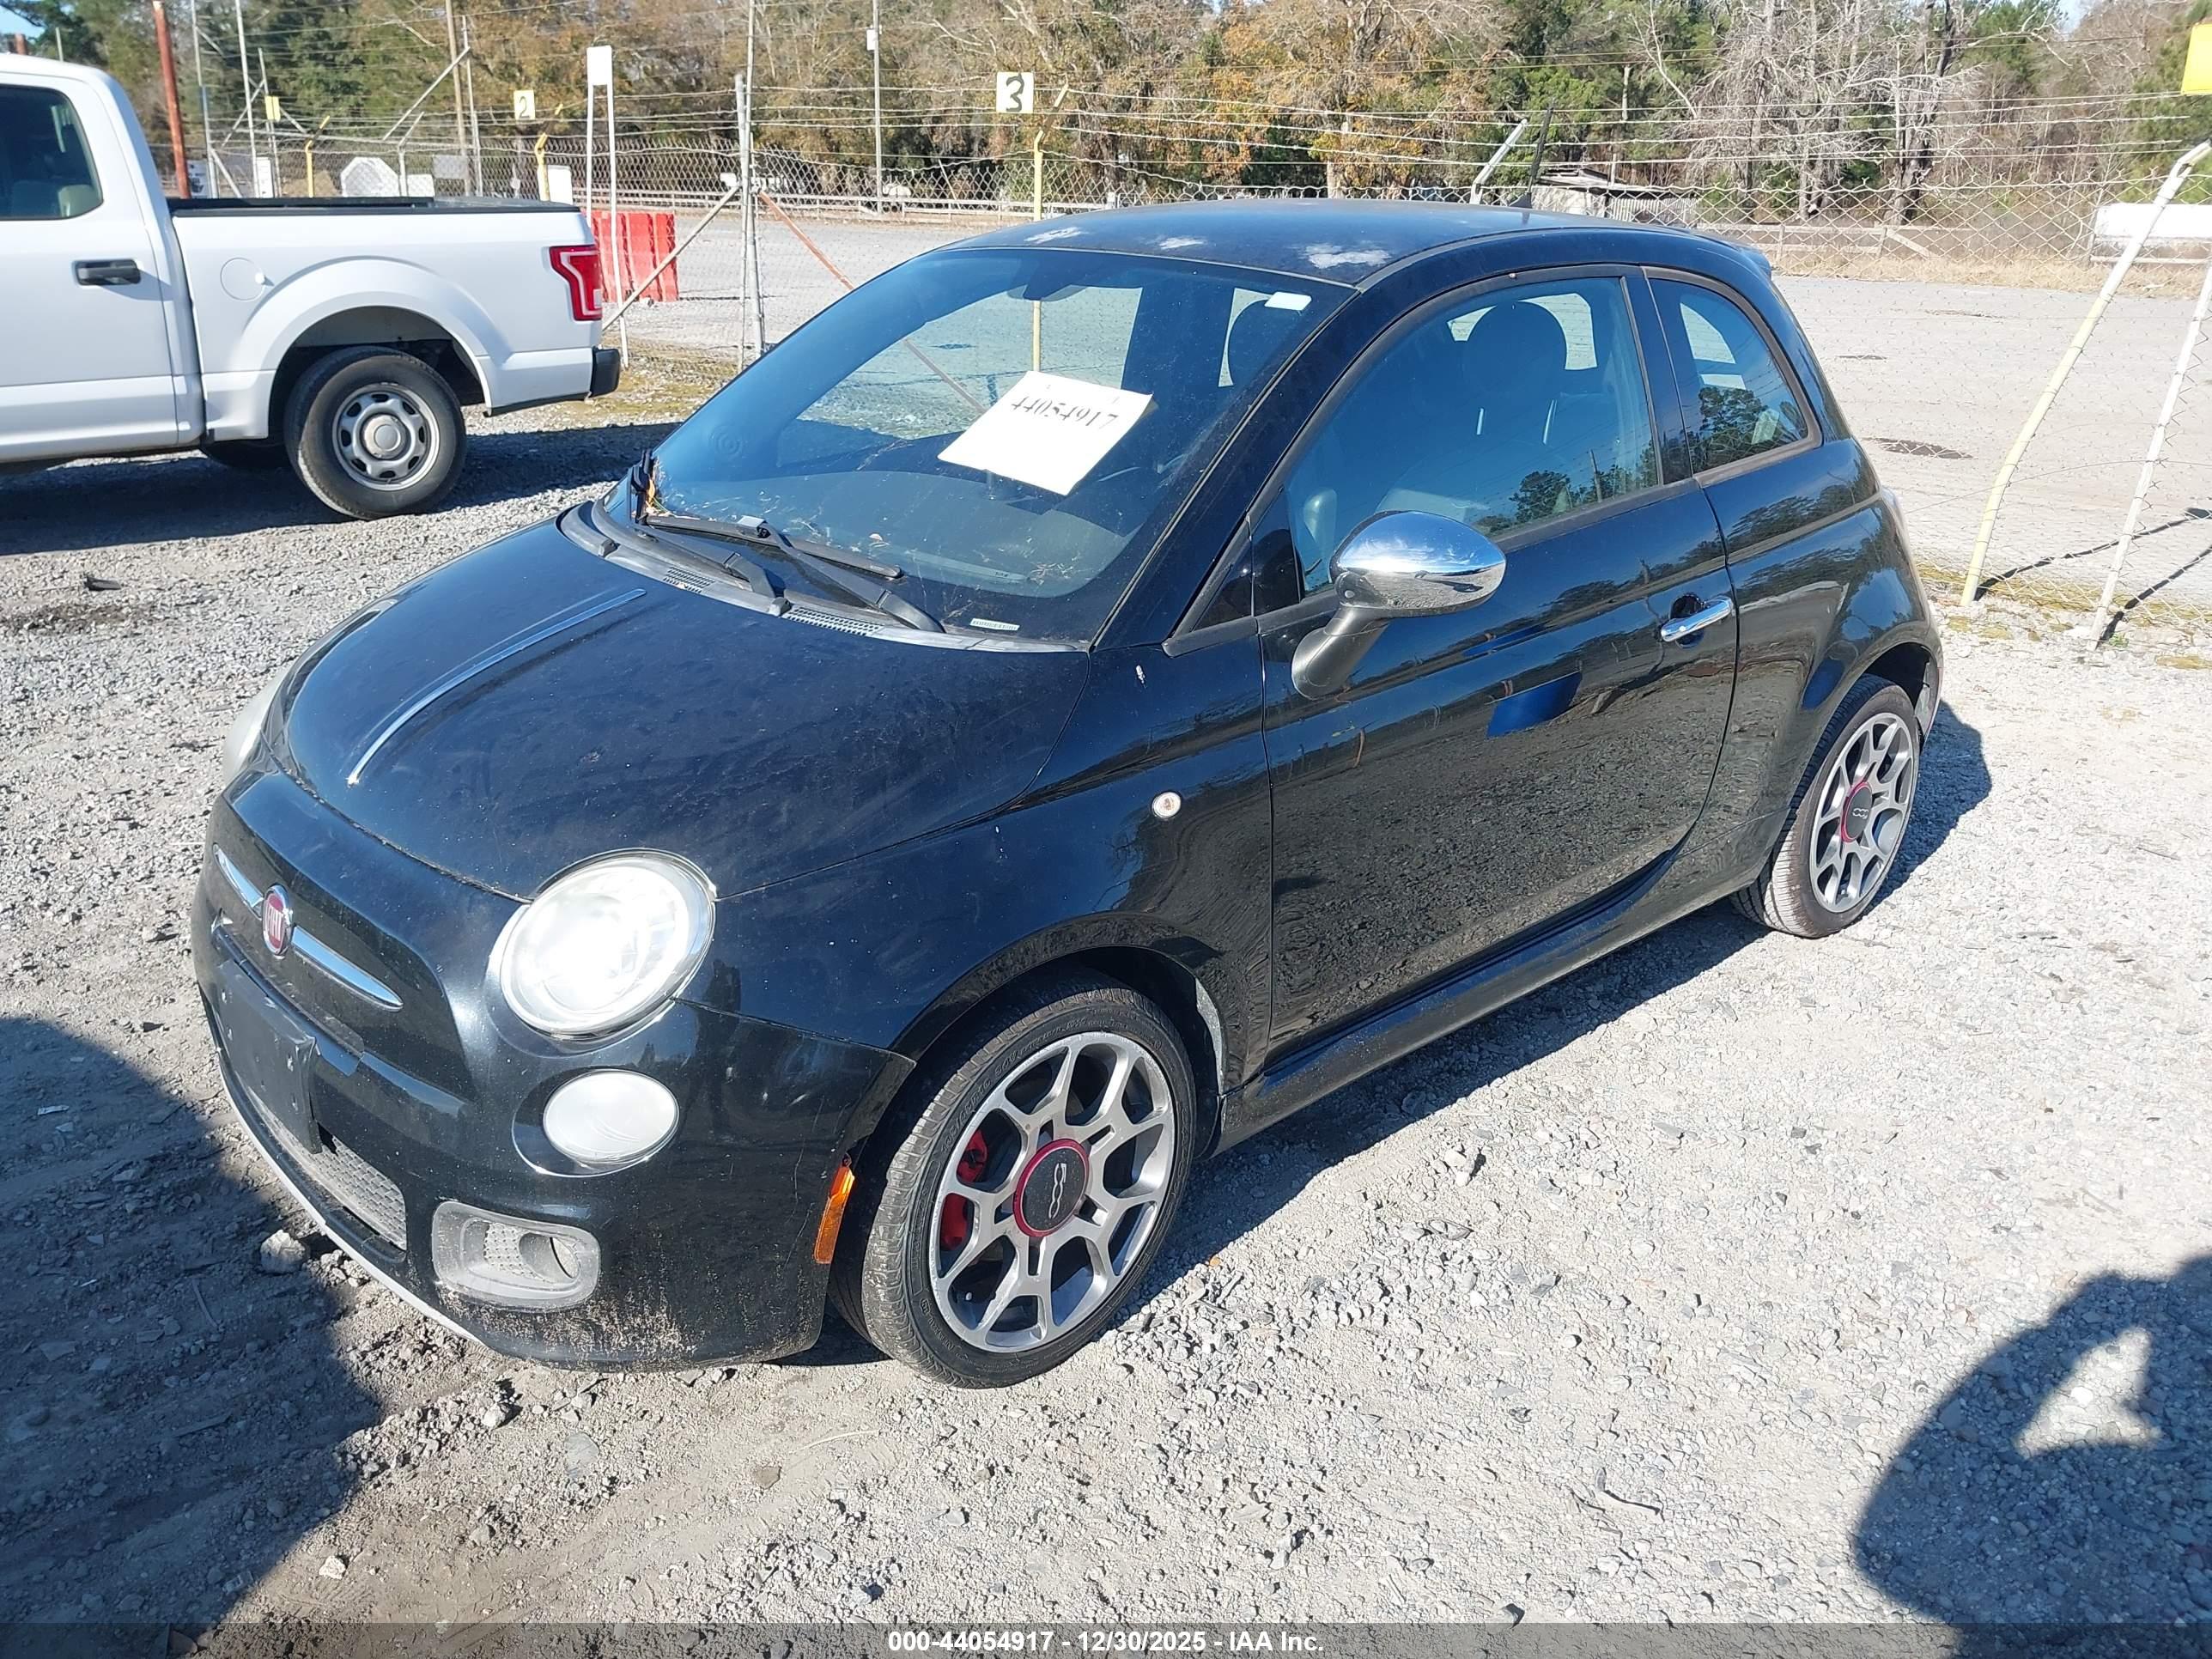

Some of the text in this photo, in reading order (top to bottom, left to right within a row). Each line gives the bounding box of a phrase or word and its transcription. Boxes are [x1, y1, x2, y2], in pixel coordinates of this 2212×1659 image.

[519, 95, 530, 118] 2
[1006, 73, 1024, 112] 3
[1011, 395, 1119, 429] 44054917
[1048, 1163, 1067, 1219] 500
